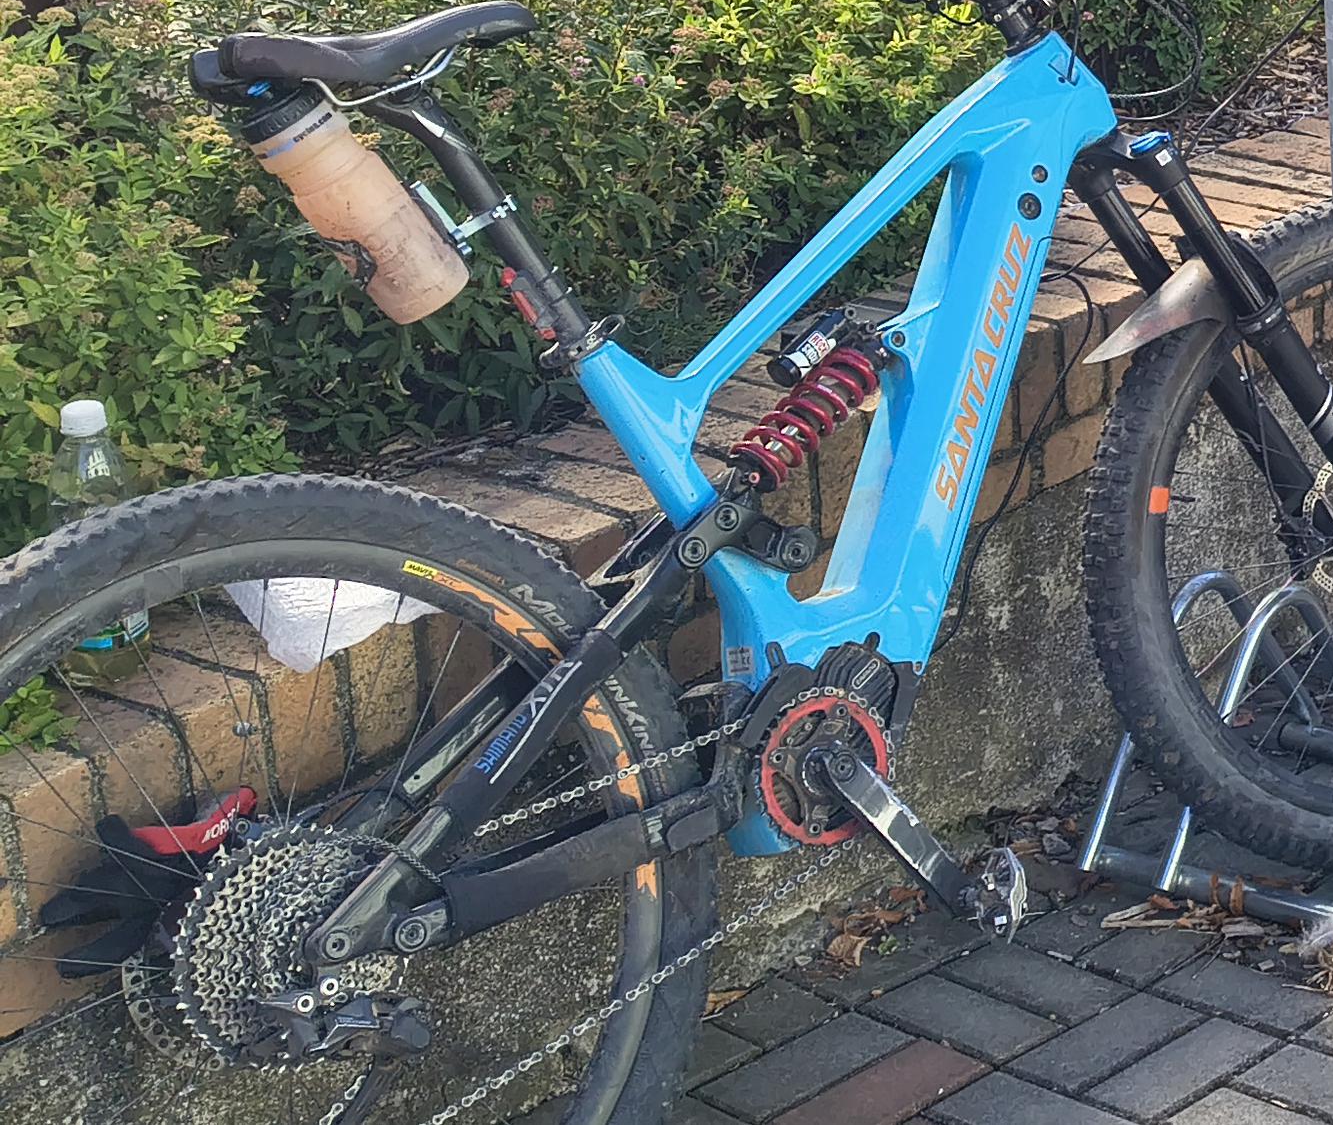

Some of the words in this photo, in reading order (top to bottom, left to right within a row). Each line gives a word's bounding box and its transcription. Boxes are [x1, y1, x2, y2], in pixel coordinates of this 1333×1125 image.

[936, 348, 997, 511] SANTA
[983, 223, 1034, 349] CRUZ
[474, 715, 527, 774] SHIMANO
